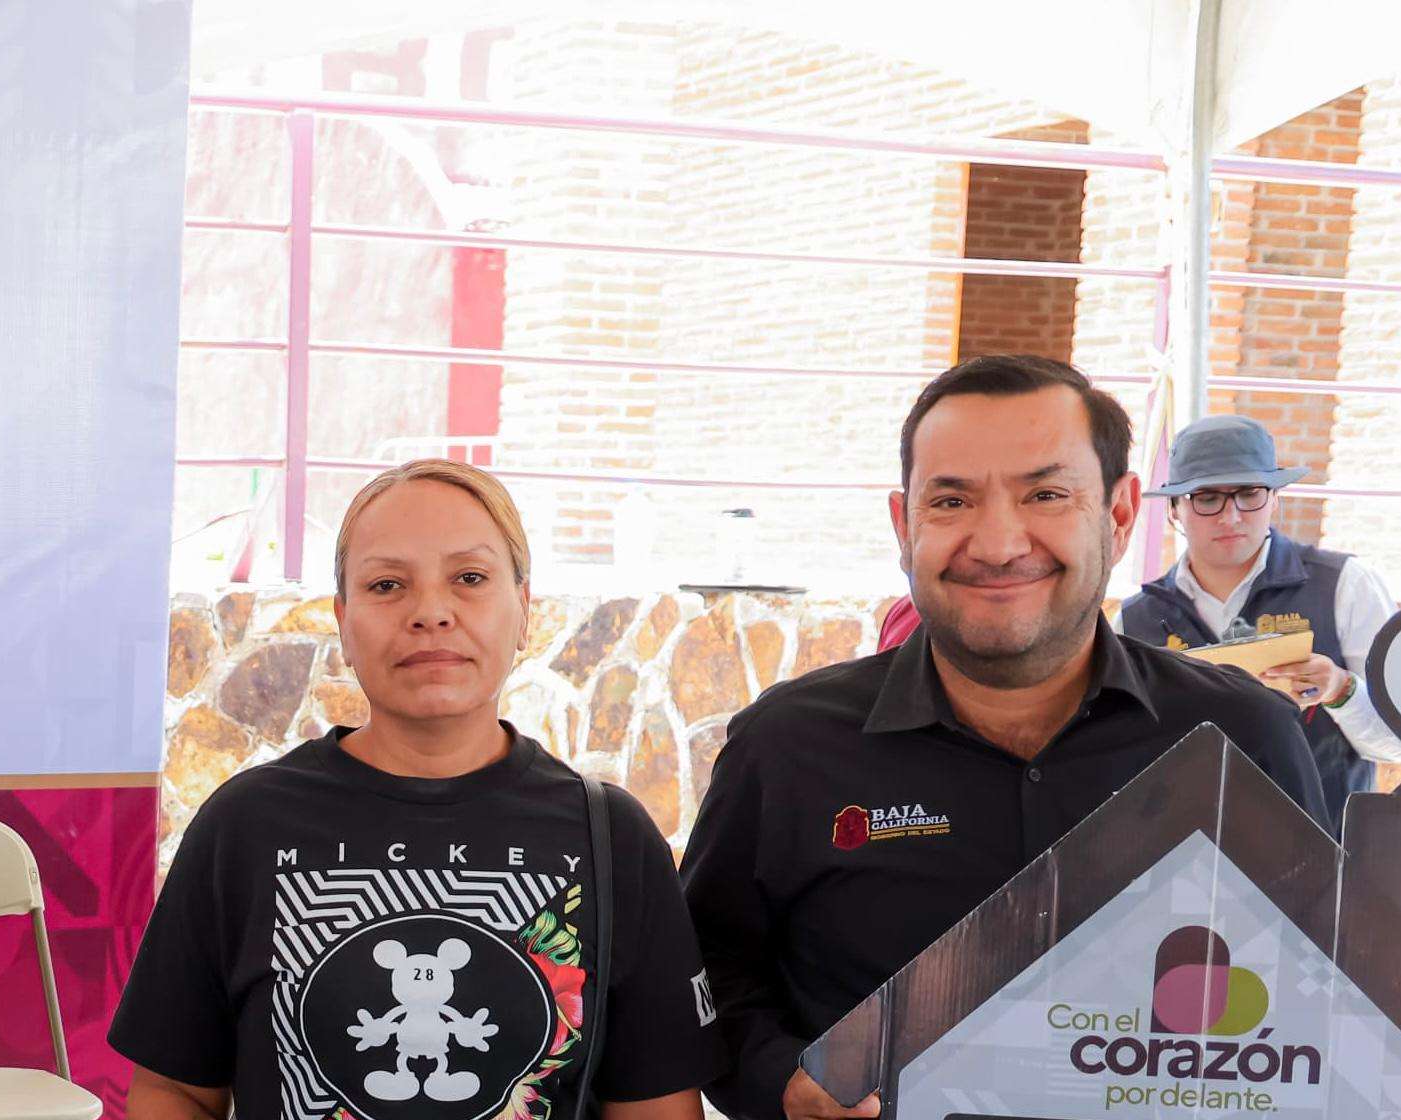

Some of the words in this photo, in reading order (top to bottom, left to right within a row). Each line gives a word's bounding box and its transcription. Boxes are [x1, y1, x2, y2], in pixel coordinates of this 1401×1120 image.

[871, 803, 927, 822] BAJA
[871, 814, 949, 831] CALIFORNIA
[277, 842, 582, 873] MICKEY
[413, 967, 435, 982] 28
[1047, 1003, 1109, 1031] Con
[1115, 1007, 1141, 1033] el
[1070, 1027, 1322, 1085] corazón
[1105, 1084, 1157, 1111] por
[1160, 1081, 1278, 1112] delante.
